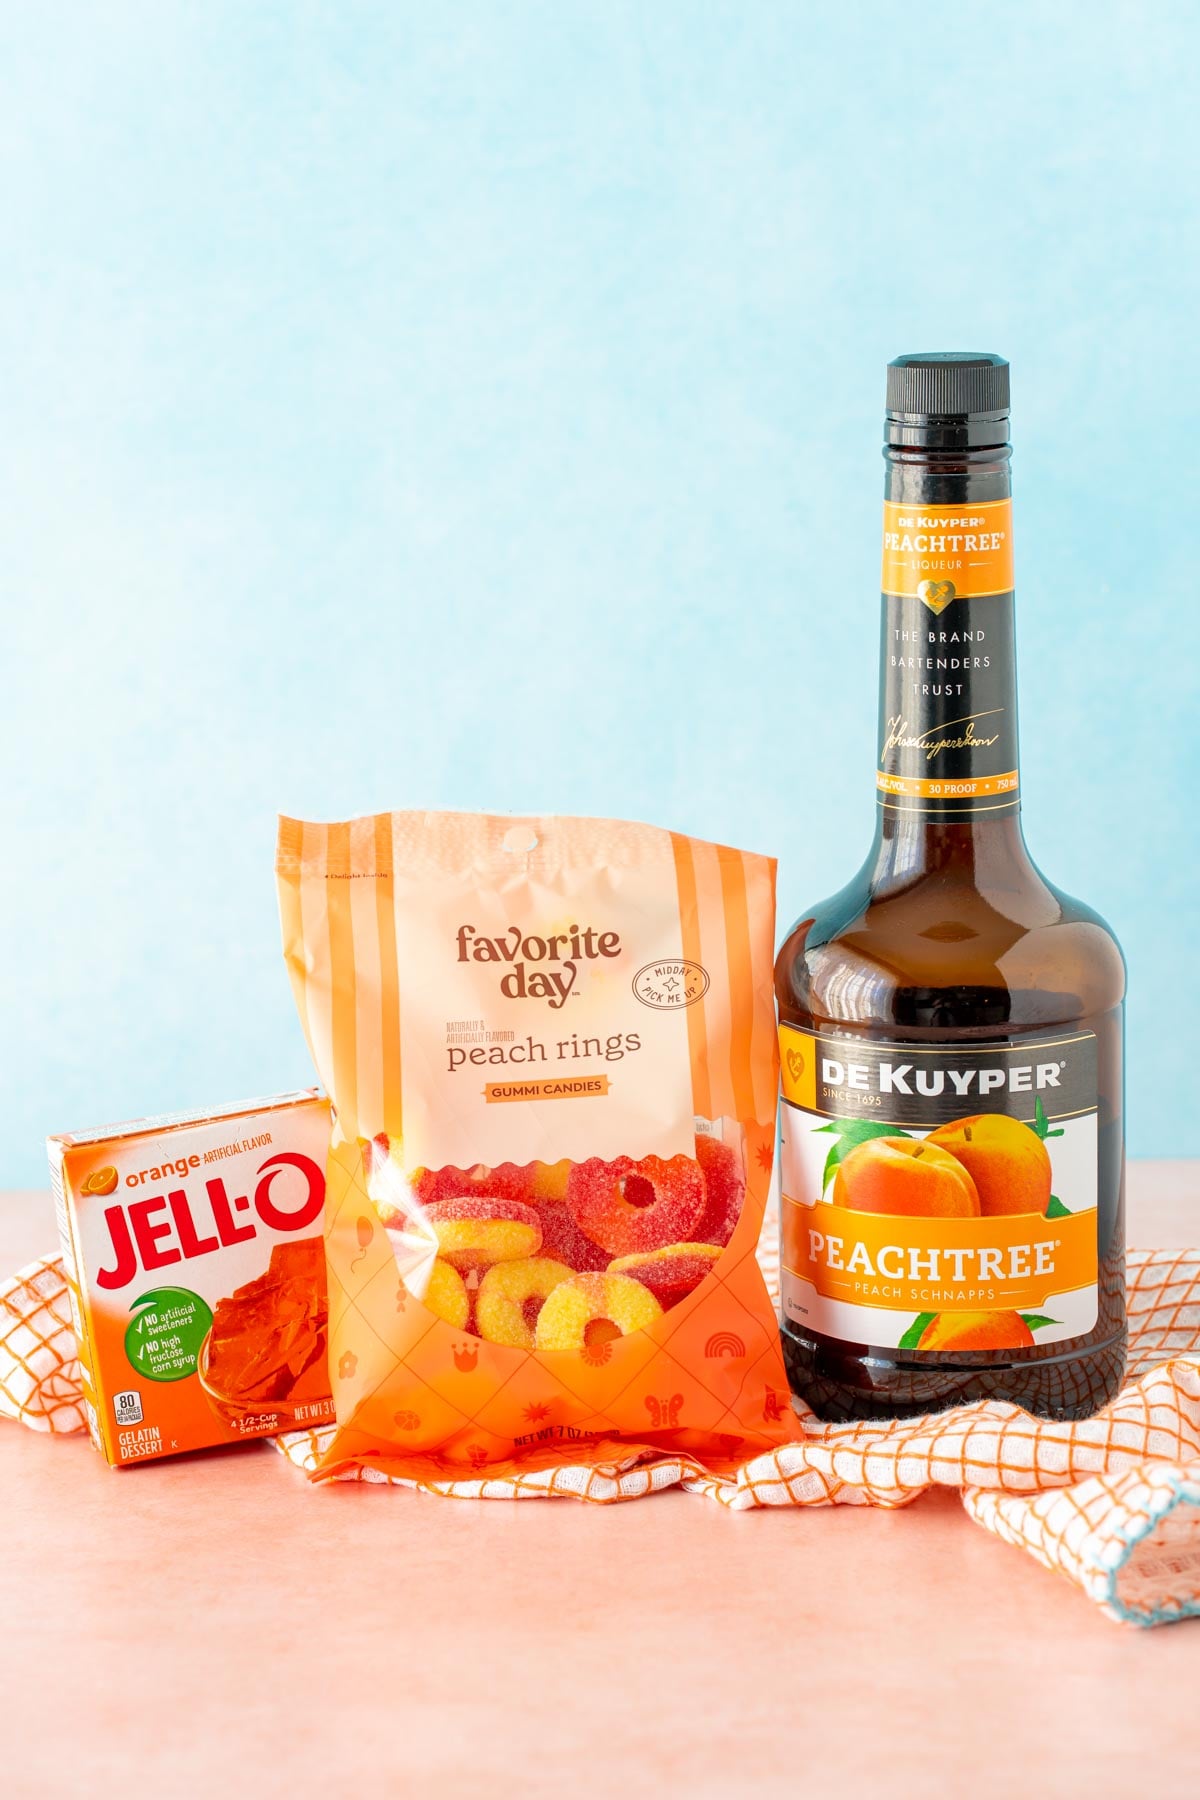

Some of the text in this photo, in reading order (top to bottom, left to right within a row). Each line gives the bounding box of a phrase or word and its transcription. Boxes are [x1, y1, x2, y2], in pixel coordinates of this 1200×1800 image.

[898, 517, 914, 528] DE
[911, 559, 963, 570] LIQUEUR
[895, 629, 985, 643] THE BRAND
[891, 655, 991, 669] BARTENDERS
[913, 684, 963, 696] TRUST
[928, 783, 977, 794] 30 PROOF
[455, 923, 622, 963] favorite
[654, 966, 692, 977] MIDDAY
[500, 960, 577, 1009] day
[642, 985, 698, 1004] PICK ME UP
[446, 1020, 485, 1033] NATURALLY &
[446, 1030, 515, 1044] ARTIFICIALLY FLAVORED
[447, 1032, 642, 1072] peach rings
[821, 1058, 870, 1091] DE
[491, 1080, 602, 1098] GUMMI CANDIES
[822, 1086, 882, 1106] SINCE 1695
[125, 1132, 273, 1188] orange ARTIFICIAL FLAVOR
[854, 1282, 995, 1300] PEACH SCHNAPPS
[144, 1302, 197, 1327] NO artificial
[147, 1315, 193, 1336] sweeteners
[146, 1335, 181, 1353] NO high
[149, 1347, 184, 1364] fructose
[152, 1354, 196, 1374] corn syrup
[119, 1393, 136, 1409] 80
[116, 1405, 141, 1417] CALORIES
[294, 1405, 309, 1421] NET
[309, 1402, 322, 1417] WT
[324, 1401, 330, 1415] 3
[230, 1419, 237, 1428] 4
[239, 1420, 278, 1434] Servings
[118, 1427, 160, 1446] GELATIN
[513, 1433, 535, 1448] NET
[536, 1426, 556, 1441] WT
[556, 1425, 564, 1438] 7
[567, 1426, 581, 1440] OZ
[120, 1440, 178, 1459] DESSERT K
